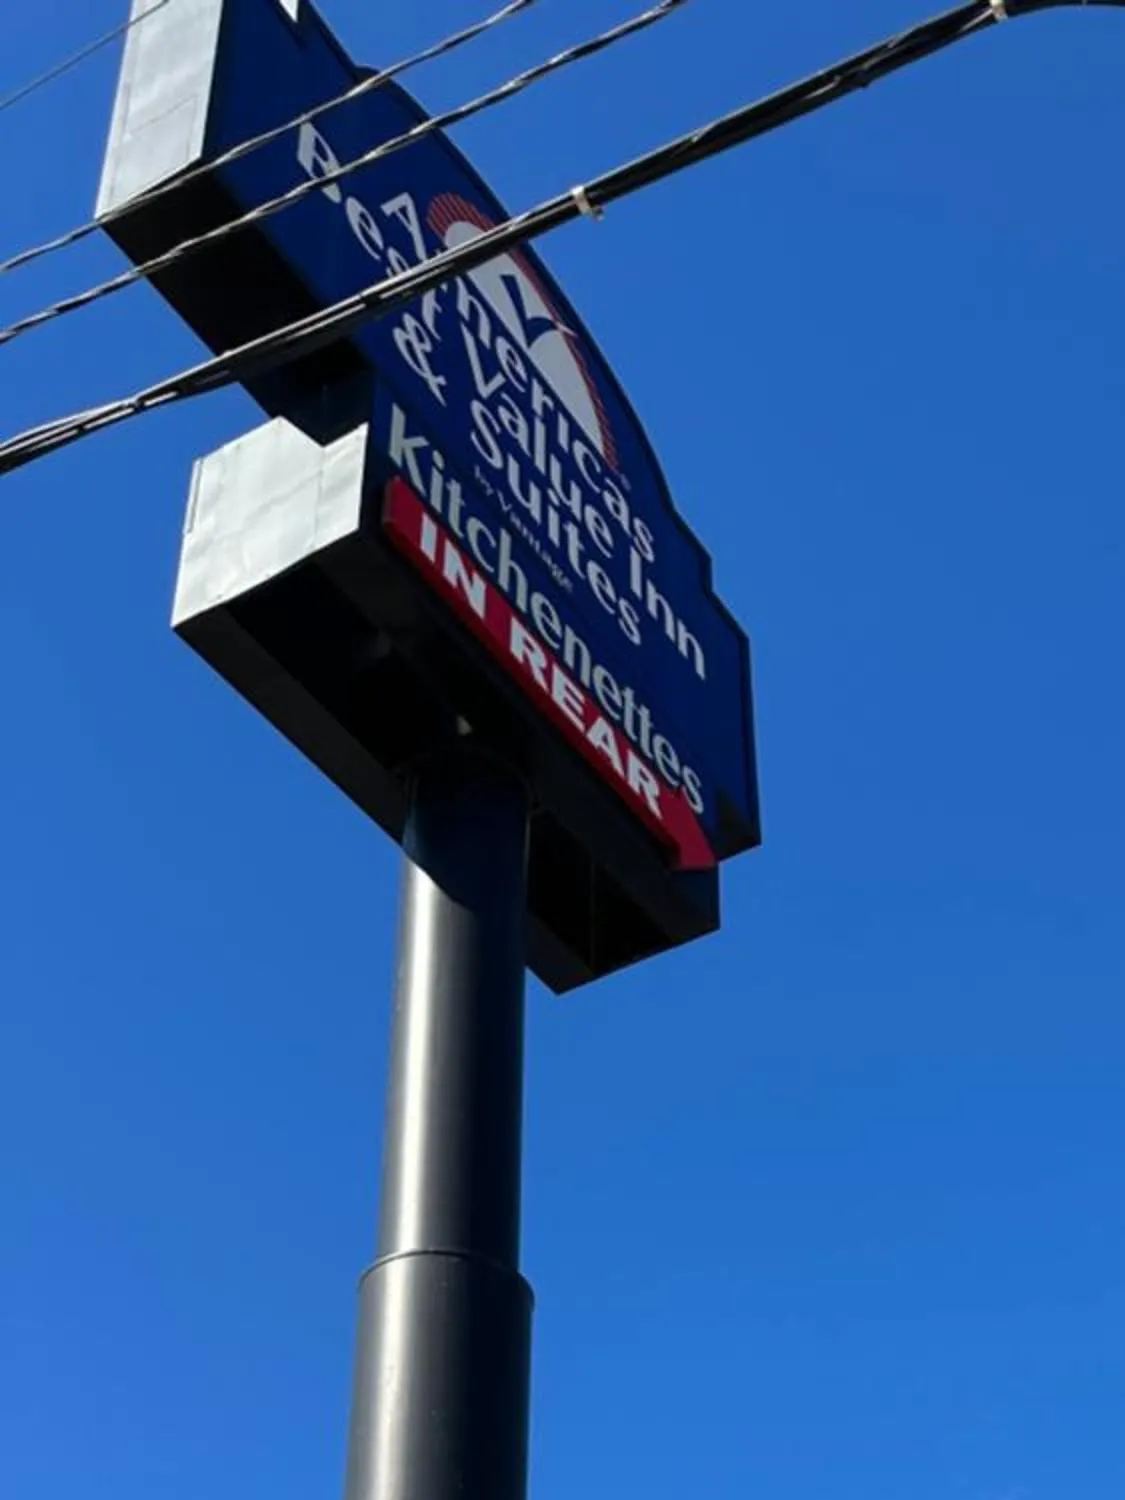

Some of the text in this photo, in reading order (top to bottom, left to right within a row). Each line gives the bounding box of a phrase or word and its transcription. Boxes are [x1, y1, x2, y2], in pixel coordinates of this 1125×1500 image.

[389, 406, 704, 815] Kitchenettes
[392, 312, 642, 646] & Suites
[460, 321, 614, 559] Value
[629, 545, 705, 680] Inn
[418, 512, 664, 820] IN REAR
